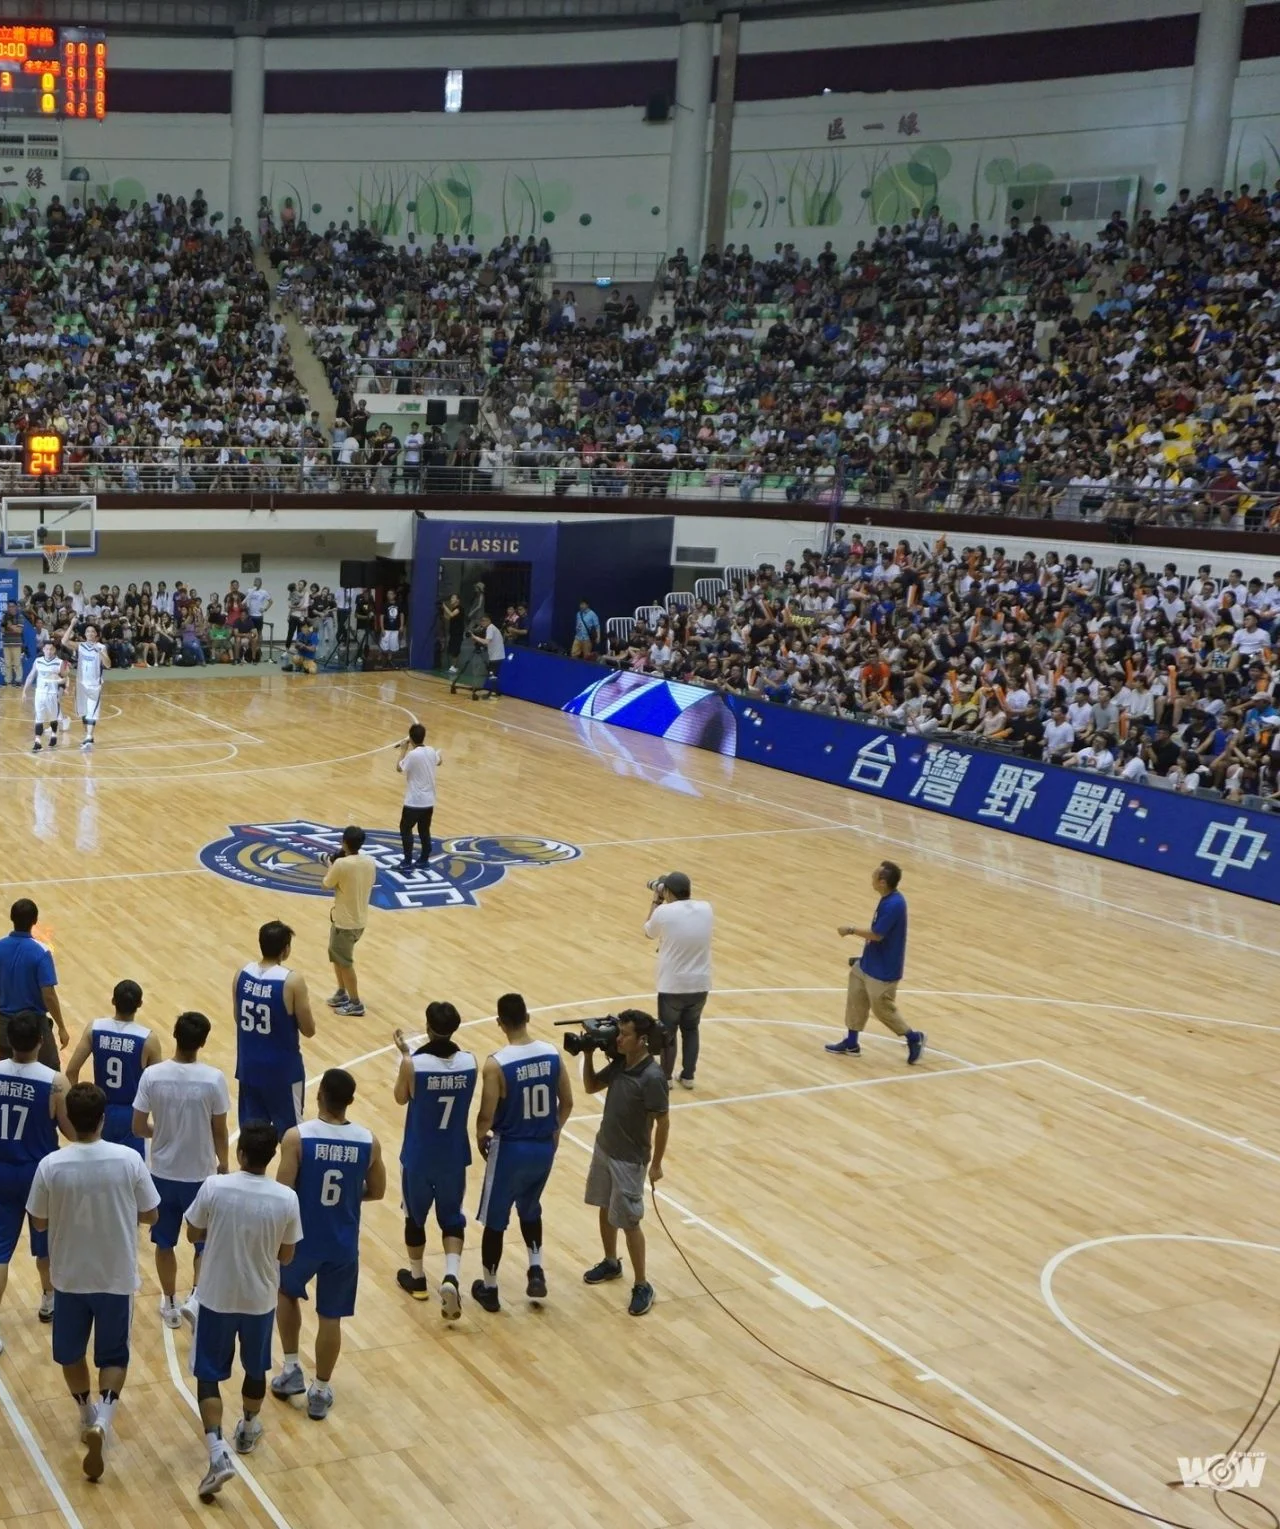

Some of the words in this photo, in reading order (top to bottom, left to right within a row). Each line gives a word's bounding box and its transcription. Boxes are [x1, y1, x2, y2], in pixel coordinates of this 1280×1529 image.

[31, 452, 56, 473] 24
[450, 538, 520, 553] CLASSIC
[849, 734, 1125, 848] 台灣野獸
[1195, 816, 1268, 878] 中
[240, 999, 272, 1035] 53
[105, 1056, 123, 1089] 9
[437, 1096, 456, 1130] 7
[522, 1083, 551, 1120] 10
[0, 1103, 30, 1141] 17
[320, 1168, 344, 1207] 6
